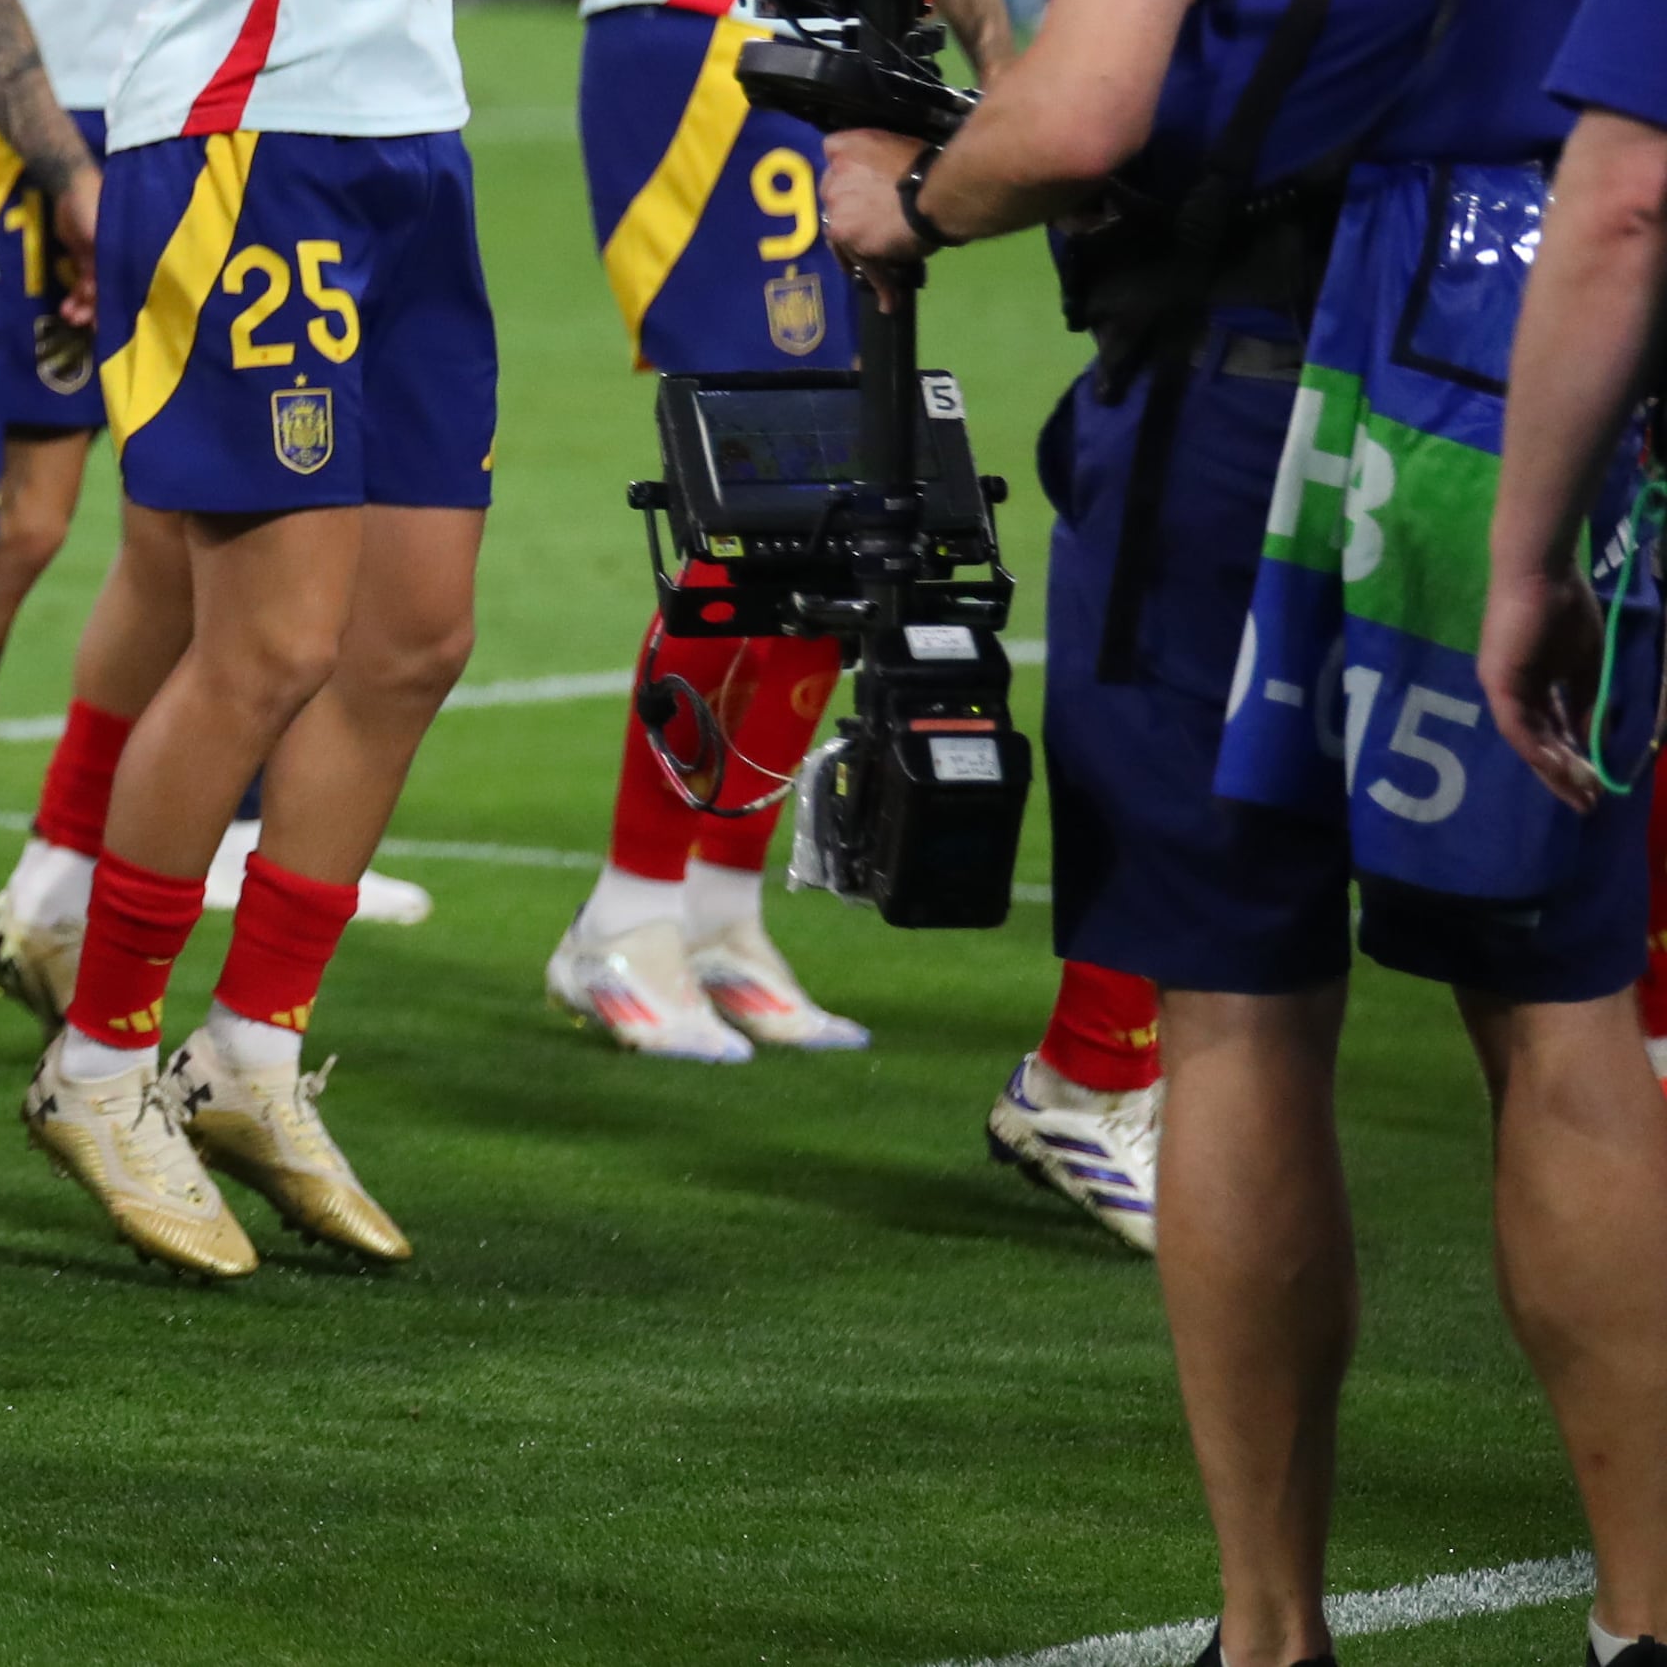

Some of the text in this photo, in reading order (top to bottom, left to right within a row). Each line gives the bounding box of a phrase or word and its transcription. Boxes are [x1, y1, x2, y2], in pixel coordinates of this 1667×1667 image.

[750, 147, 818, 262] 9
[222, 240, 361, 369] 25
[931, 385, 956, 411] 5
